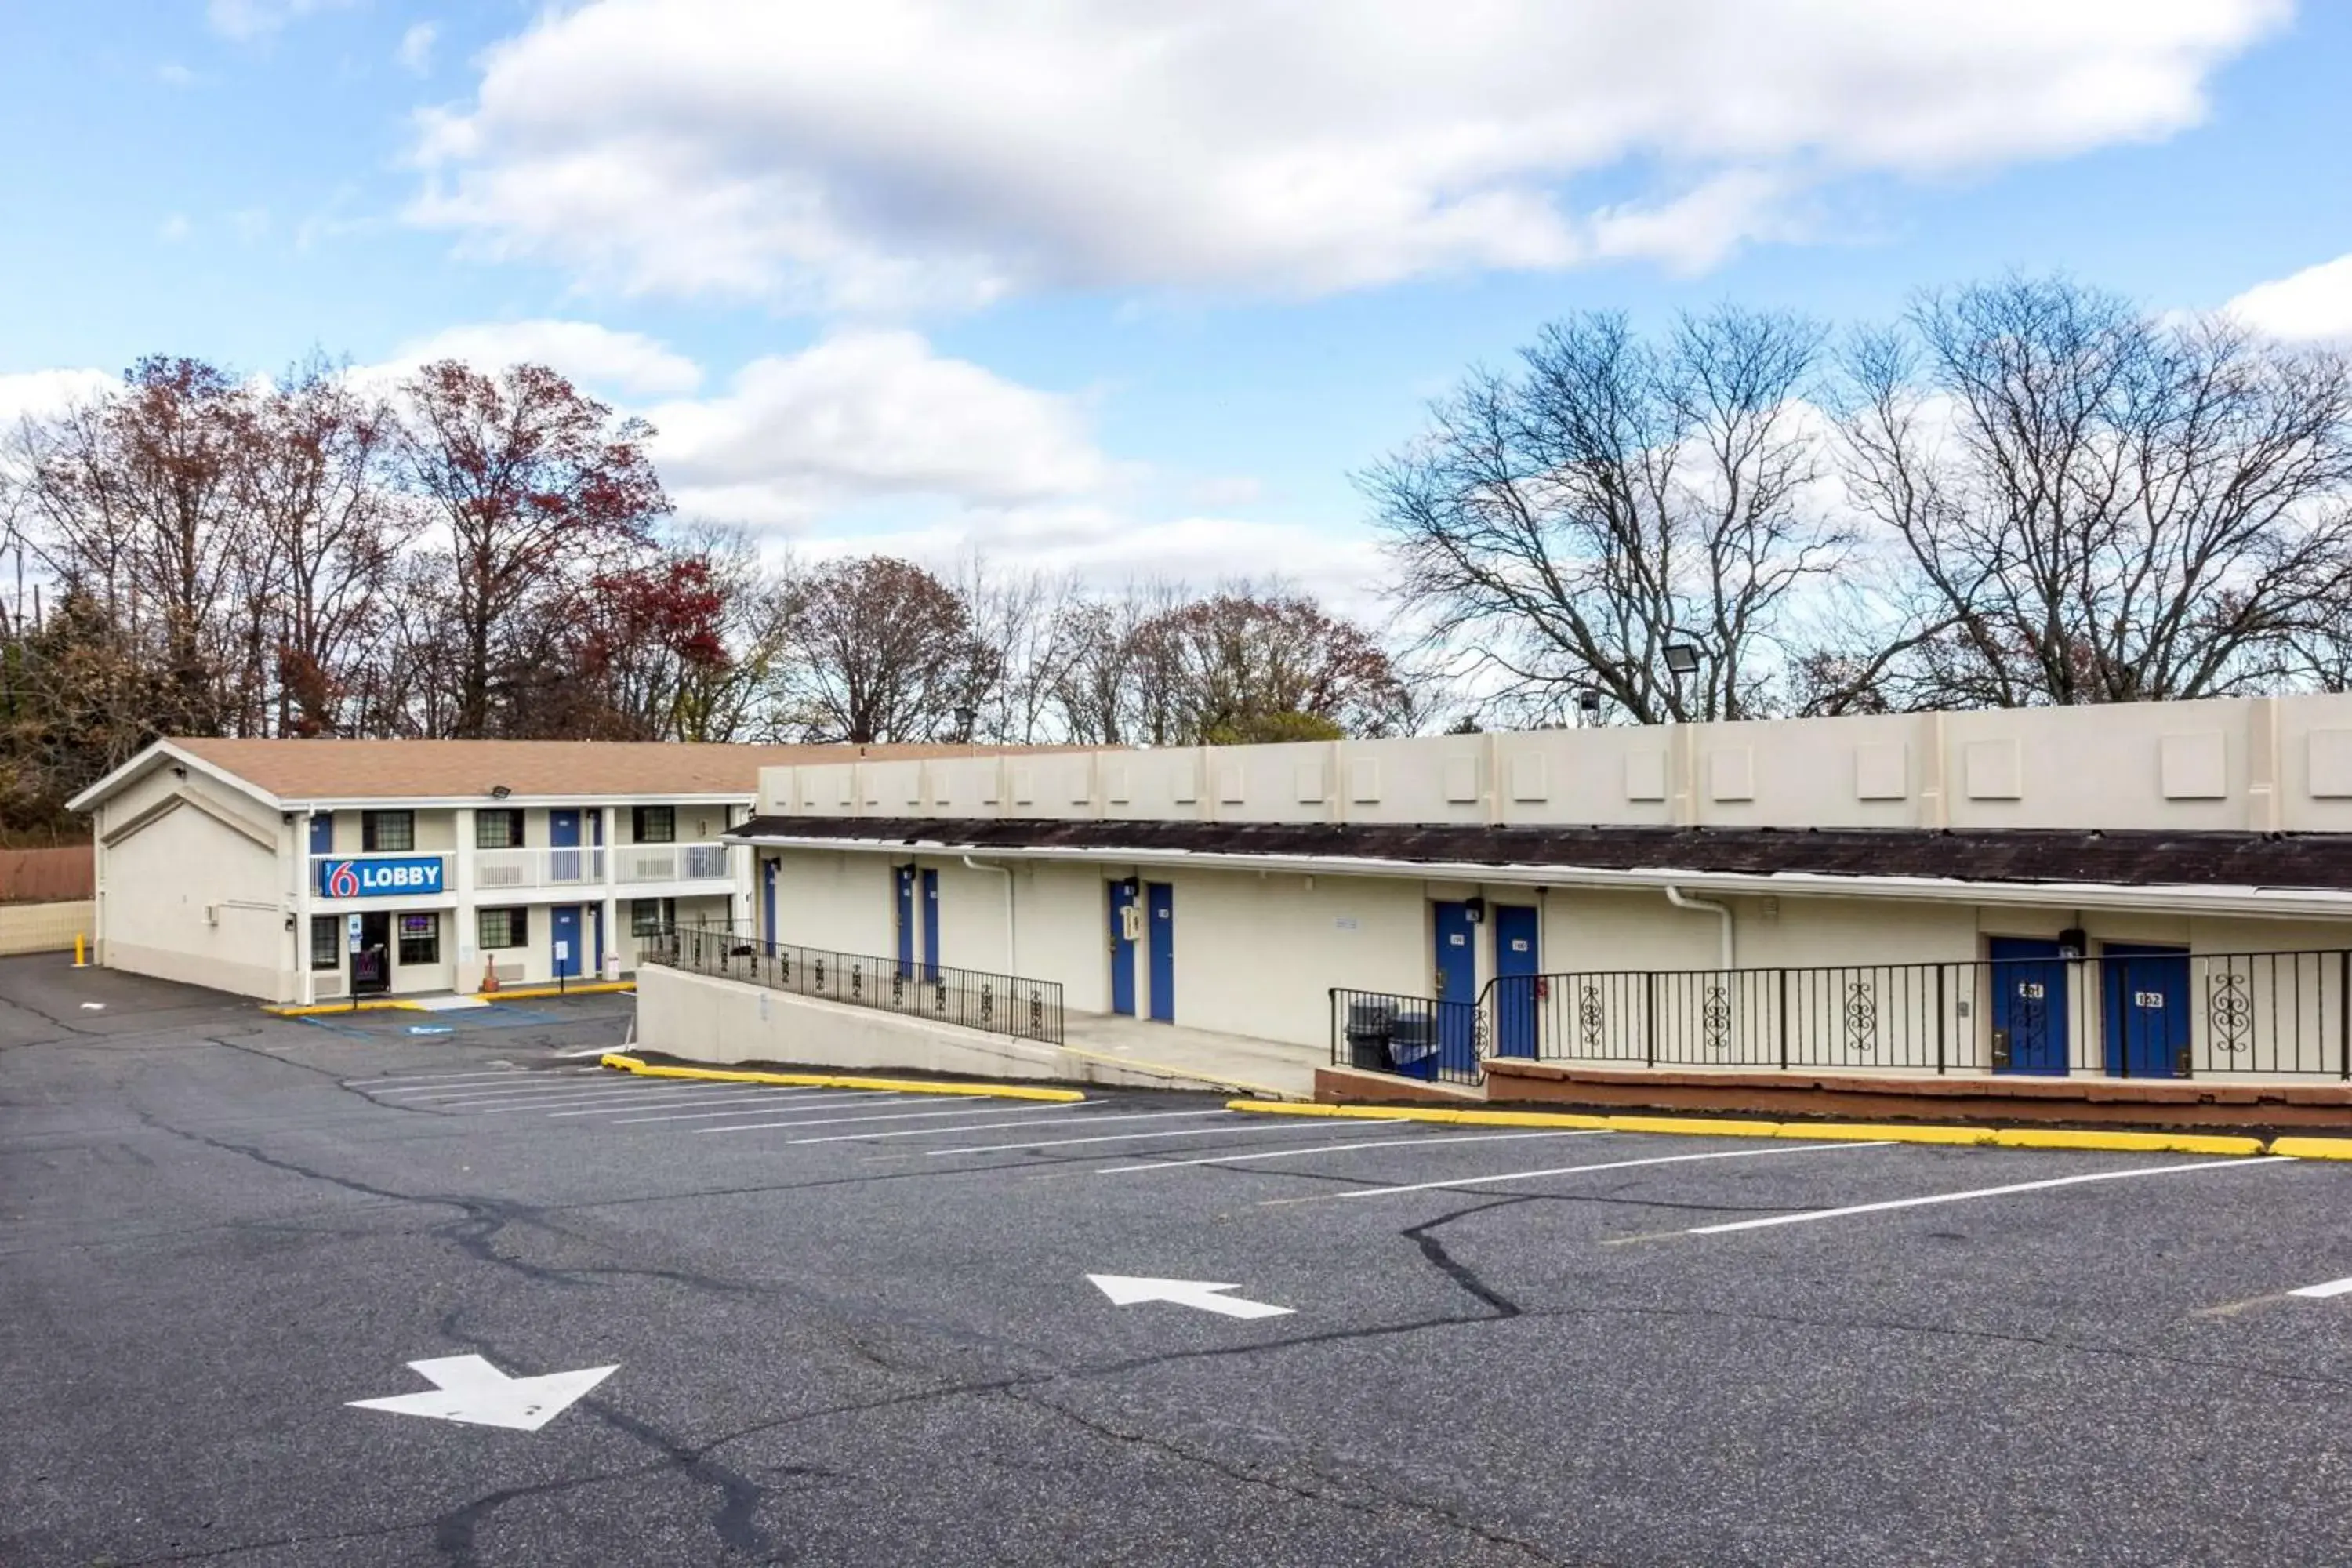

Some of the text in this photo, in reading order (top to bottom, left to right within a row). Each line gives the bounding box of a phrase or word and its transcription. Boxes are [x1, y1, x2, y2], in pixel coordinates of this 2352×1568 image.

[329, 862, 359, 898] 6
[363, 866, 439, 887] LOBBY
[2140, 994, 2160, 1005] 162
